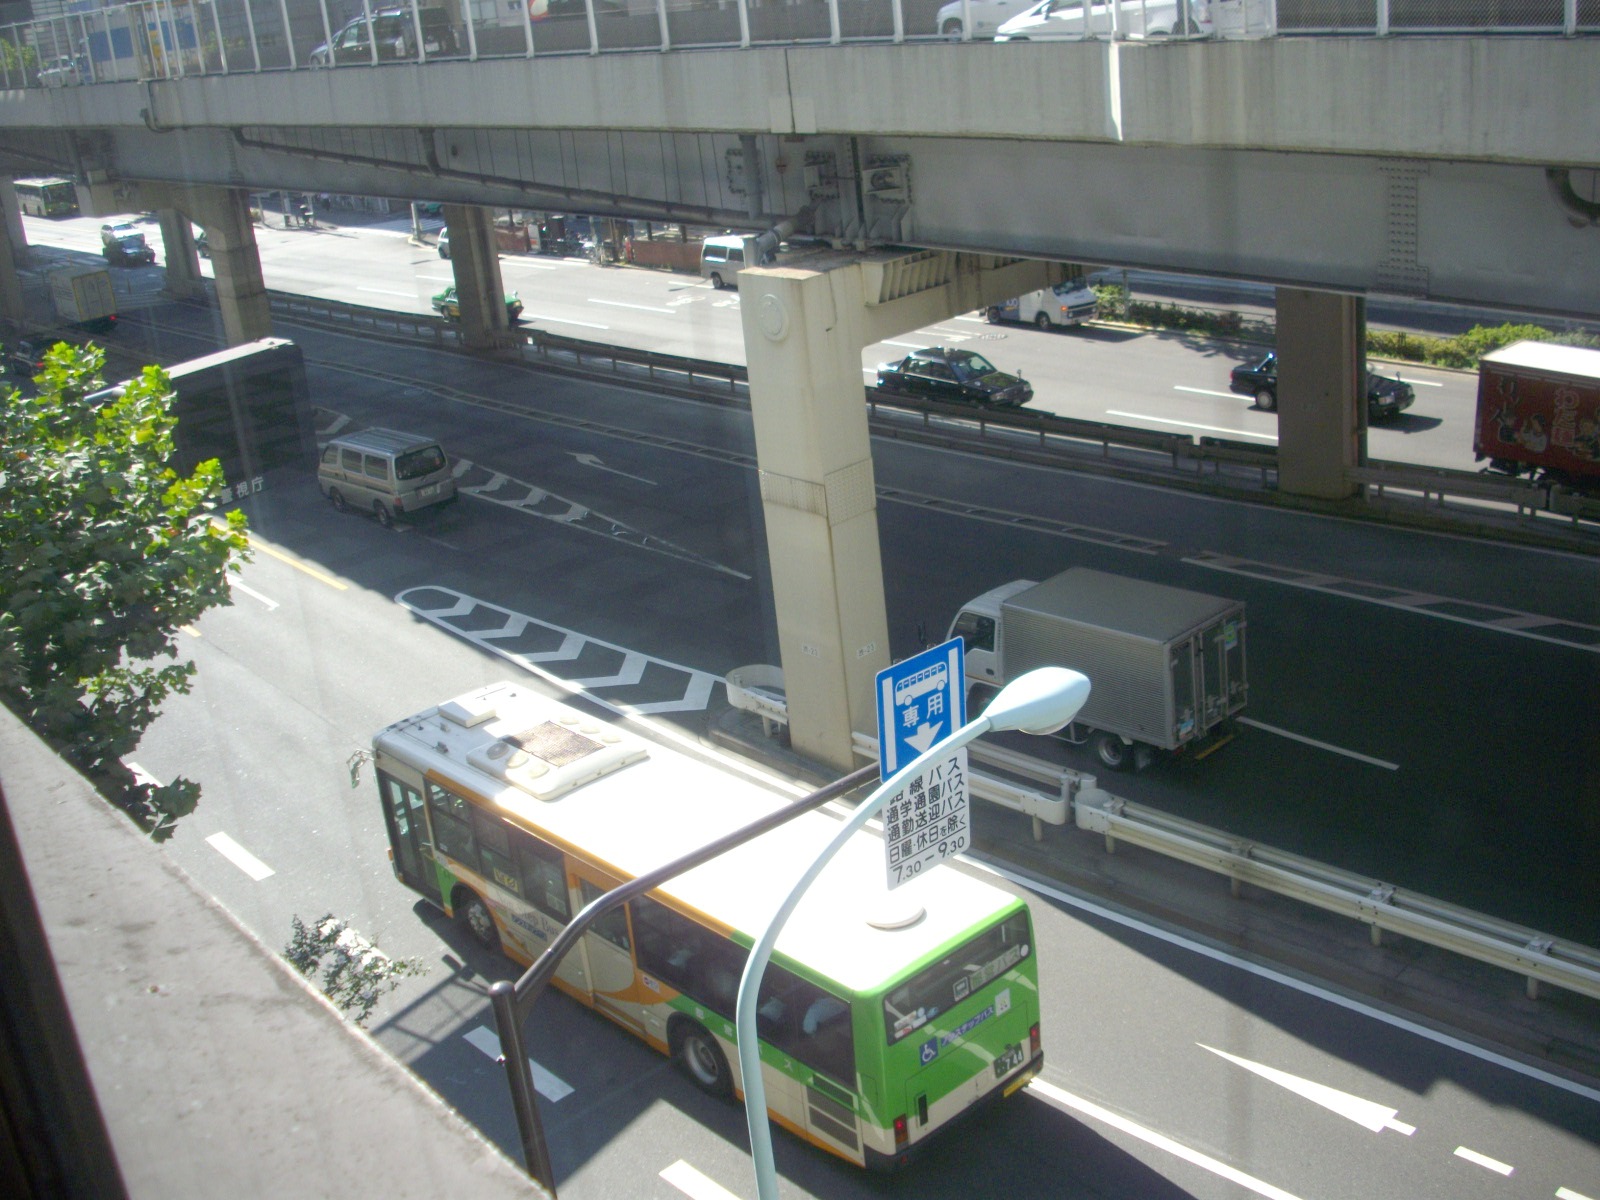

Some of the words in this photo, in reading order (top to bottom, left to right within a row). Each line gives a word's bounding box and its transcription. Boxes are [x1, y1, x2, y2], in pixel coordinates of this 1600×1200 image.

[902, 692, 943, 728] 専用
[887, 773, 965, 826] 通学通園バス
[888, 791, 966, 844] 通勤送迎バス
